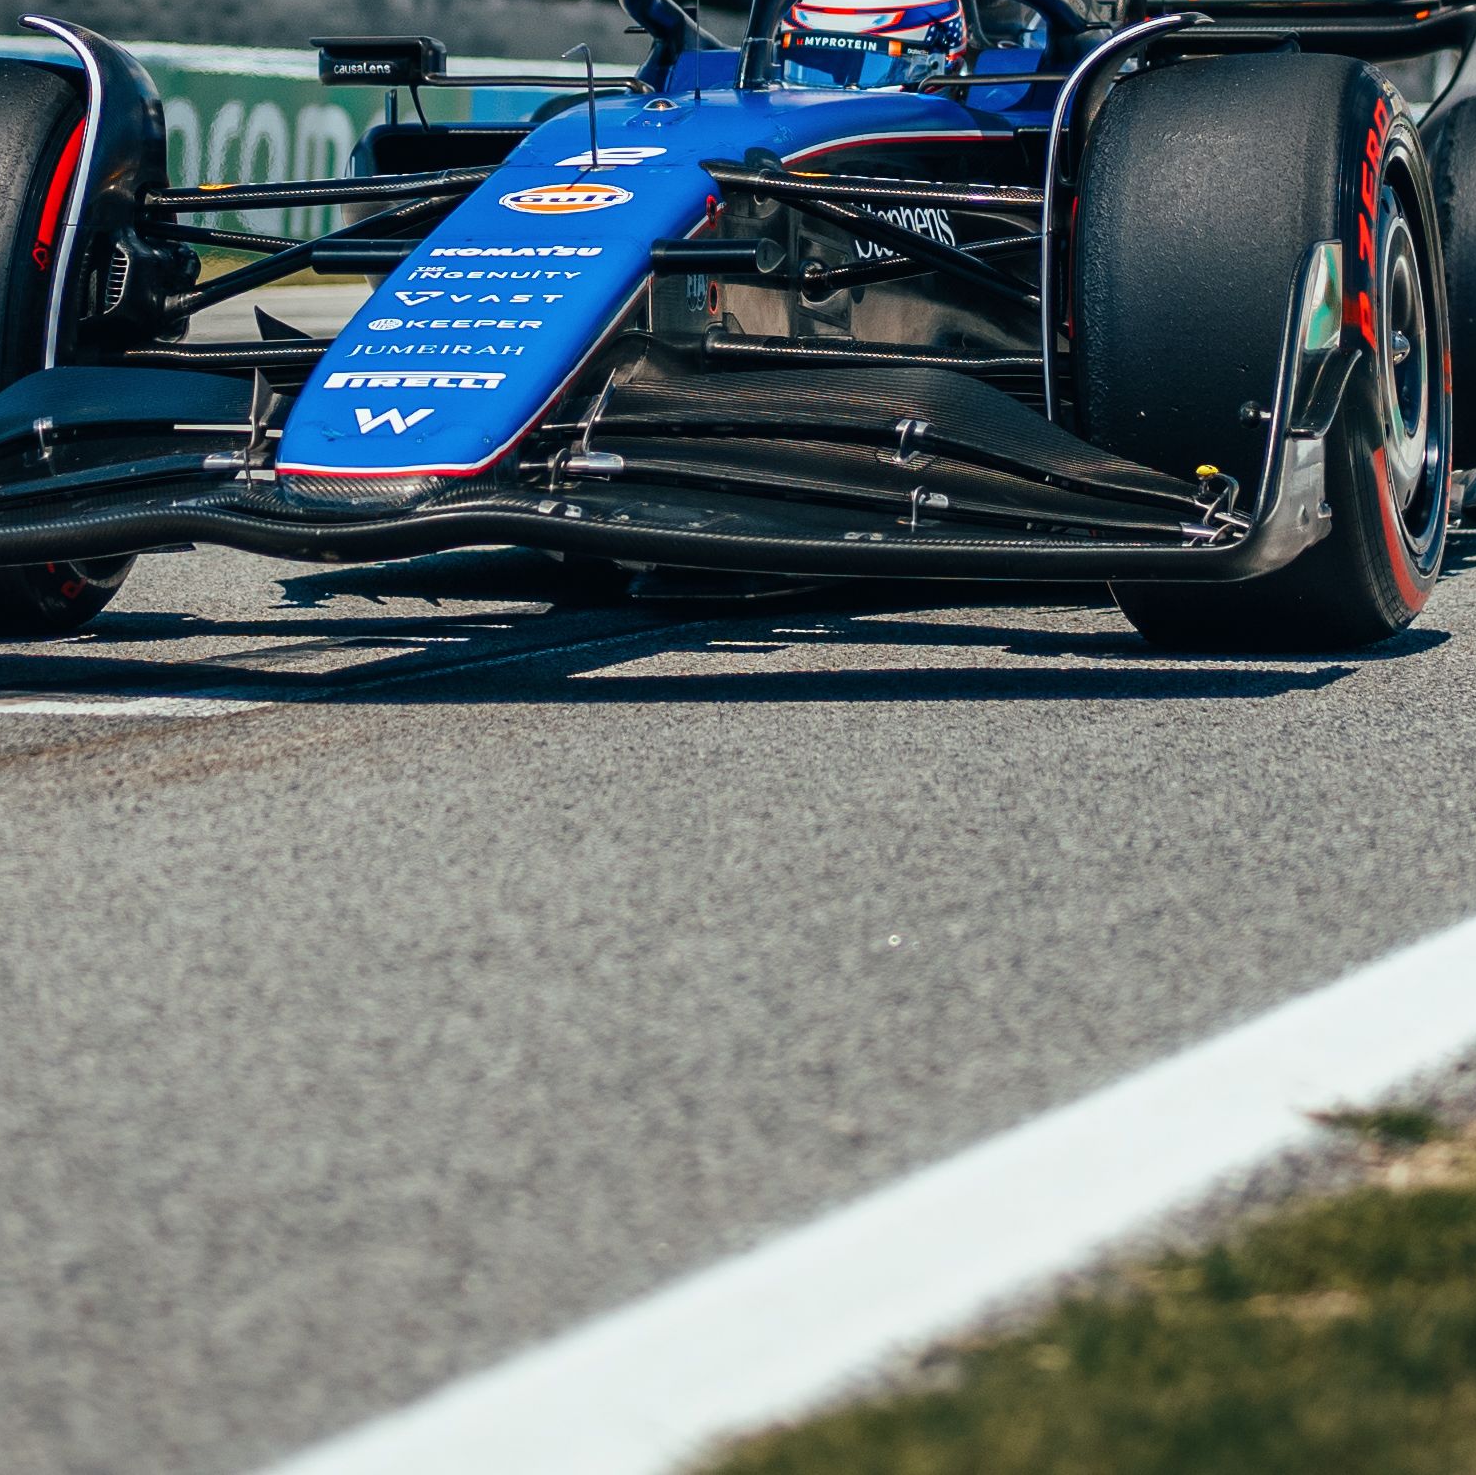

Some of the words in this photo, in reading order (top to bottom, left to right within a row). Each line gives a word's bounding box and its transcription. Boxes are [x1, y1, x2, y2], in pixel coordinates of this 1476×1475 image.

[804, 36, 877, 52] MYPROTEIN
[333, 62, 392, 75] causaLens
[429, 245, 604, 257] KOMATSU
[407, 269, 582, 281] INGENUITY
[449, 294, 564, 304] VAST
[405, 319, 544, 330] KEEPER
[344, 344, 526, 358] JUMEIRAH
[322, 370, 508, 390] PIRELLI
